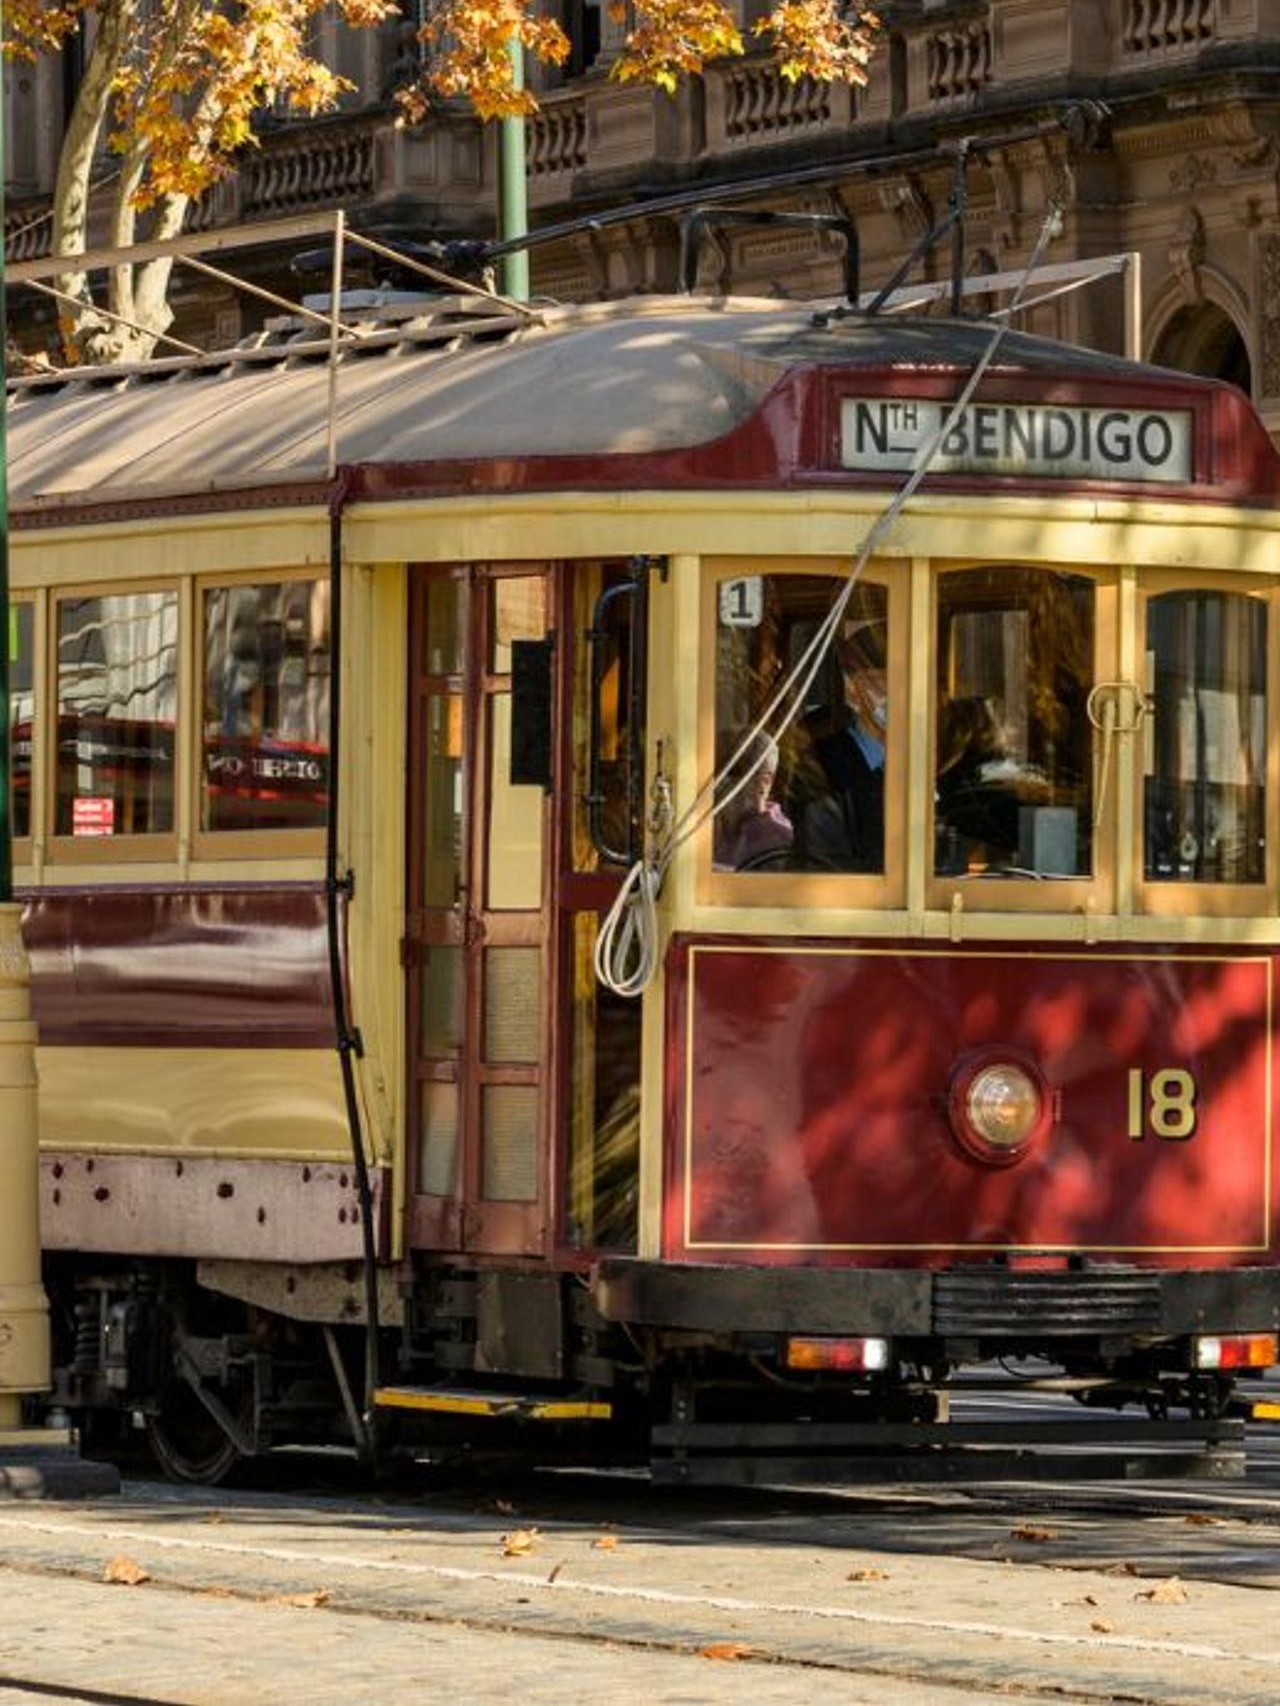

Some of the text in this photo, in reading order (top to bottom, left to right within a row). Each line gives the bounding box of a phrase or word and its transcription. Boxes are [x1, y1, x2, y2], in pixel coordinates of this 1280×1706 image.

[939, 405, 1173, 465] BENDIGO
[730, 581, 753, 619] 1
[1128, 1067, 1196, 1141] 18
